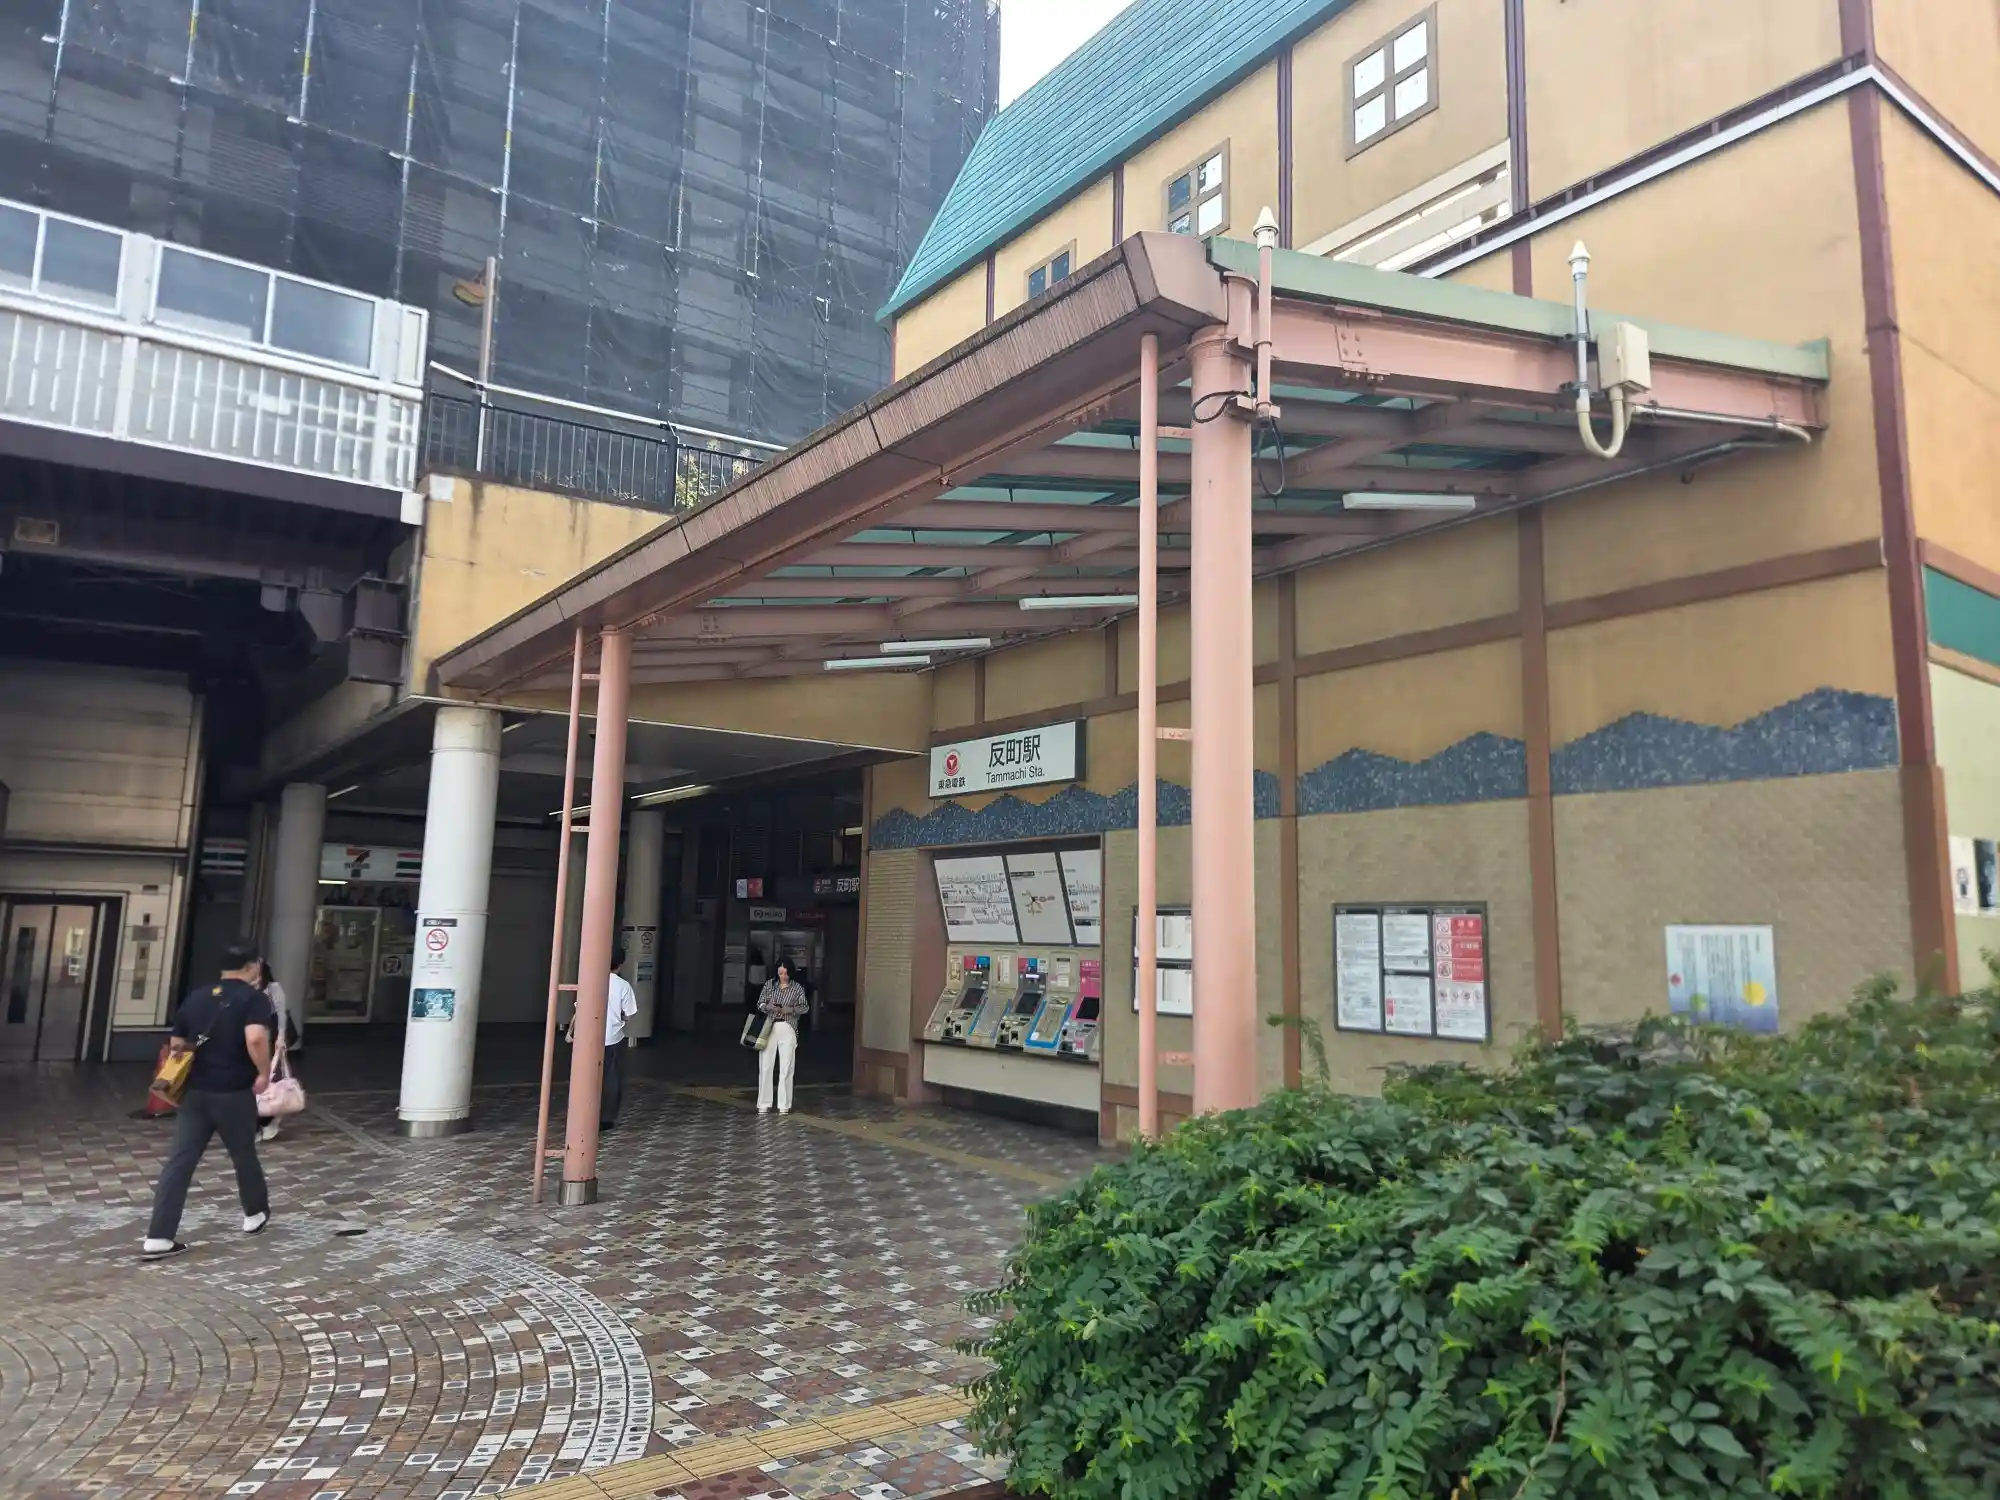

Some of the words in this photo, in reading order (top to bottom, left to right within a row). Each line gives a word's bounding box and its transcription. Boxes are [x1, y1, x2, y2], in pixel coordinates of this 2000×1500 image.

[989, 734, 1041, 768] 反町駅
[938, 777, 966, 790] 東急電鉄
[986, 767, 1027, 784] Tammachi
[1029, 765, 1045, 779] Sta.
